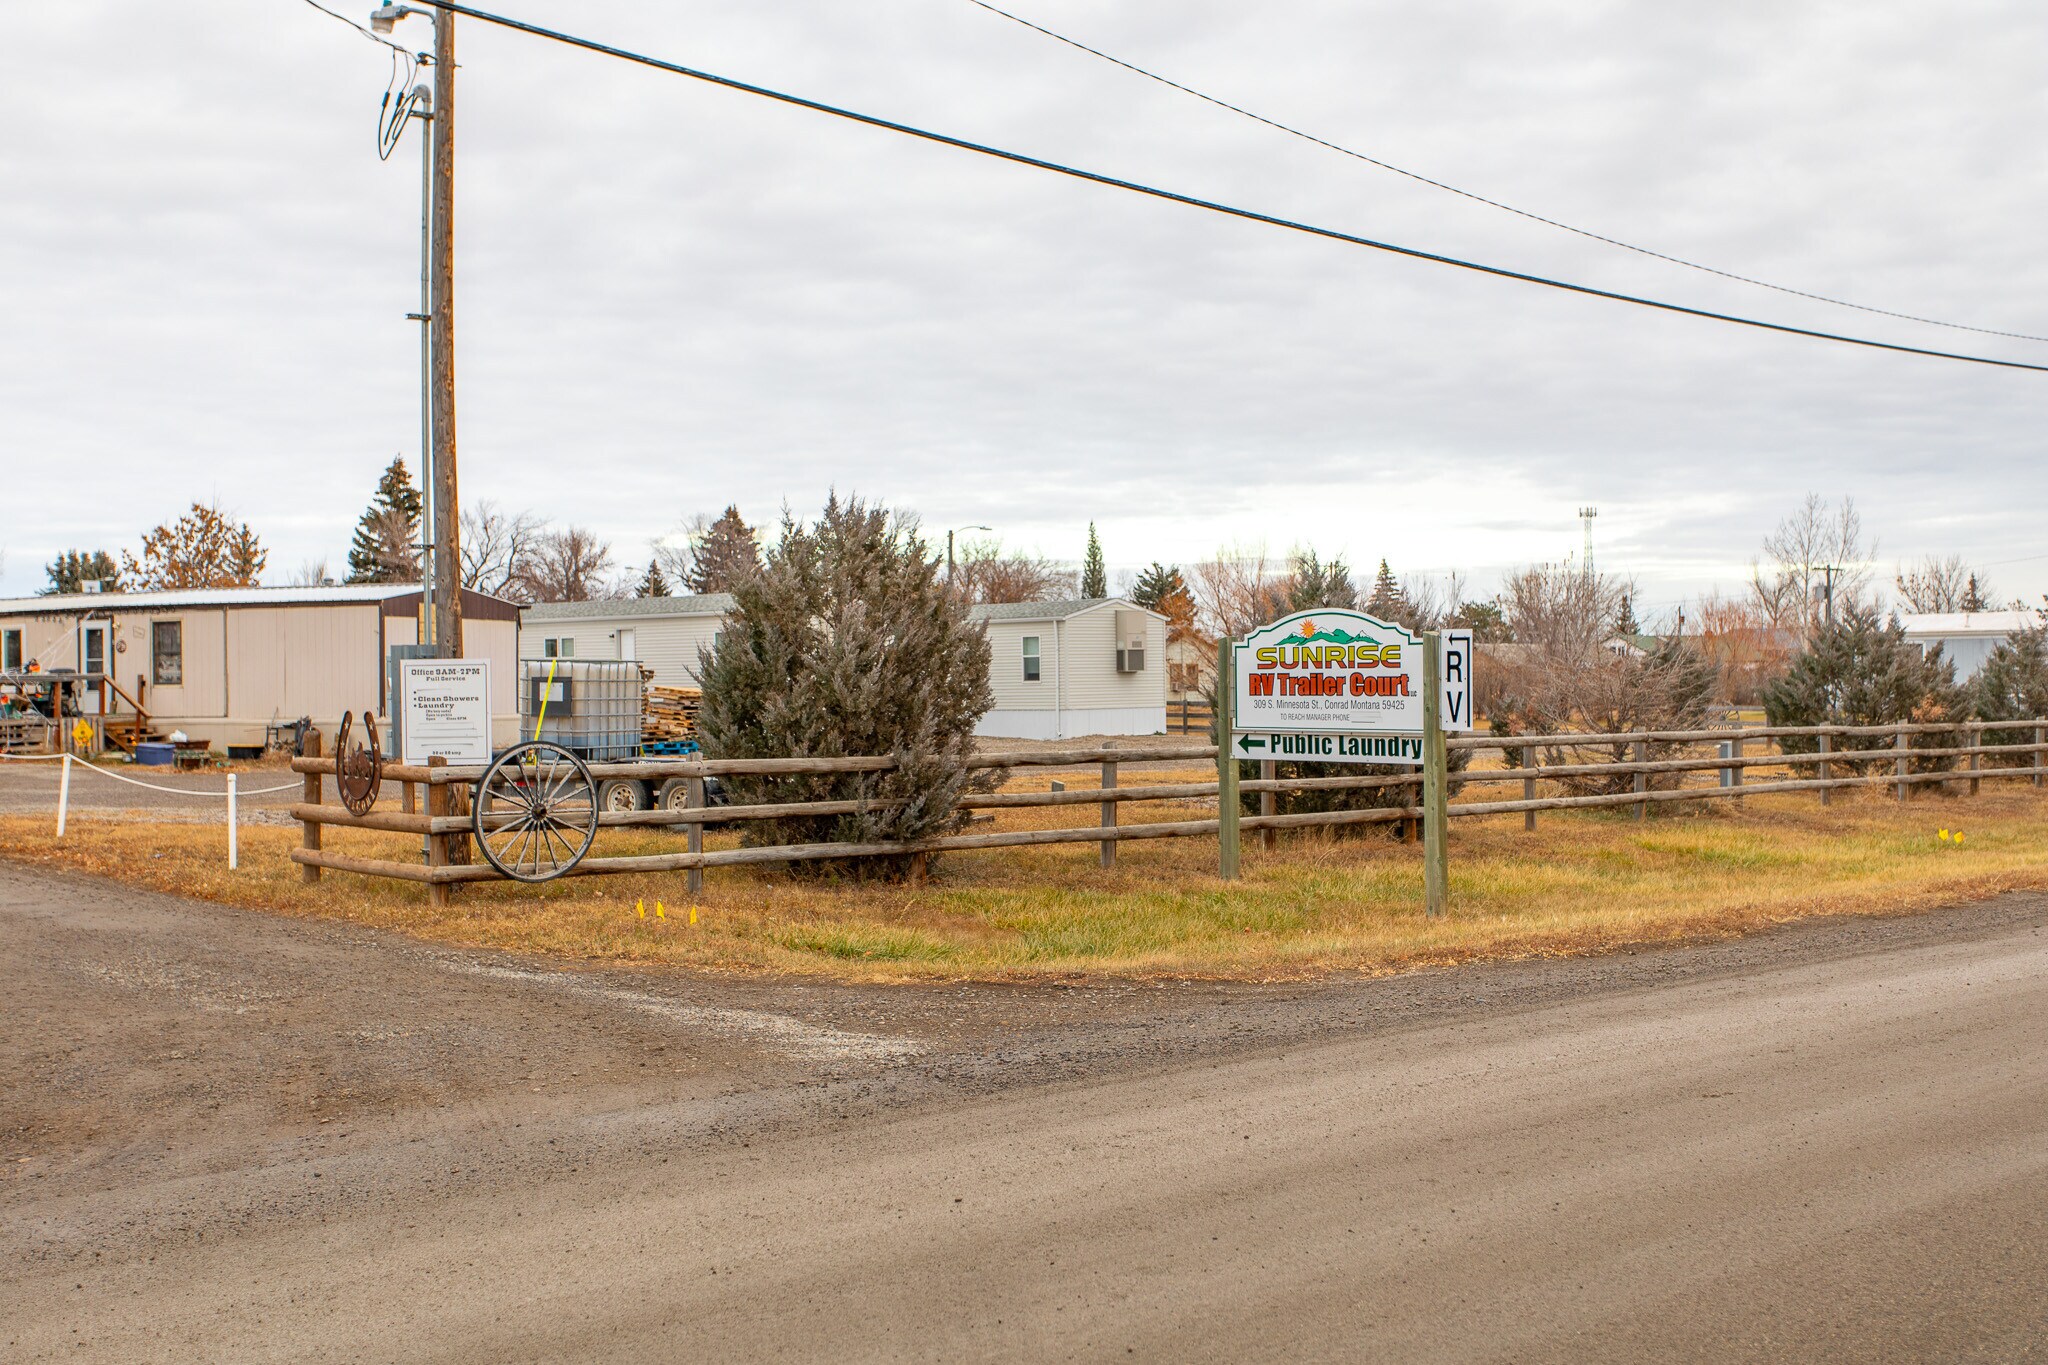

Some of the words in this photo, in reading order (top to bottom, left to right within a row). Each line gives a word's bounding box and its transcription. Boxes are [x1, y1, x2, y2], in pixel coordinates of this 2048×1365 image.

[1256, 645, 1401, 669] SUNRISE
[1249, 673, 1275, 697] RV
[1277, 672, 1346, 697] Trailer
[1349, 672, 1409, 697] Court
[1253, 700, 1267, 709] 309
[1268, 700, 1275, 709] S.
[1276, 700, 1310, 709] Minnesota
[1311, 700, 1323, 710] St.,
[1324, 700, 1349, 709] Conrad
[1350, 700, 1381, 710] Montana
[1382, 700, 1405, 710] 59425
[1280, 713, 1287, 721] TO
[1288, 713, 1306, 721] REACH
[1306, 713, 1332, 721] MANAGER
[1332, 713, 1350, 722] PHONE
[1270, 734, 1333, 755] Public
[1338, 735, 1423, 760] Laundry
